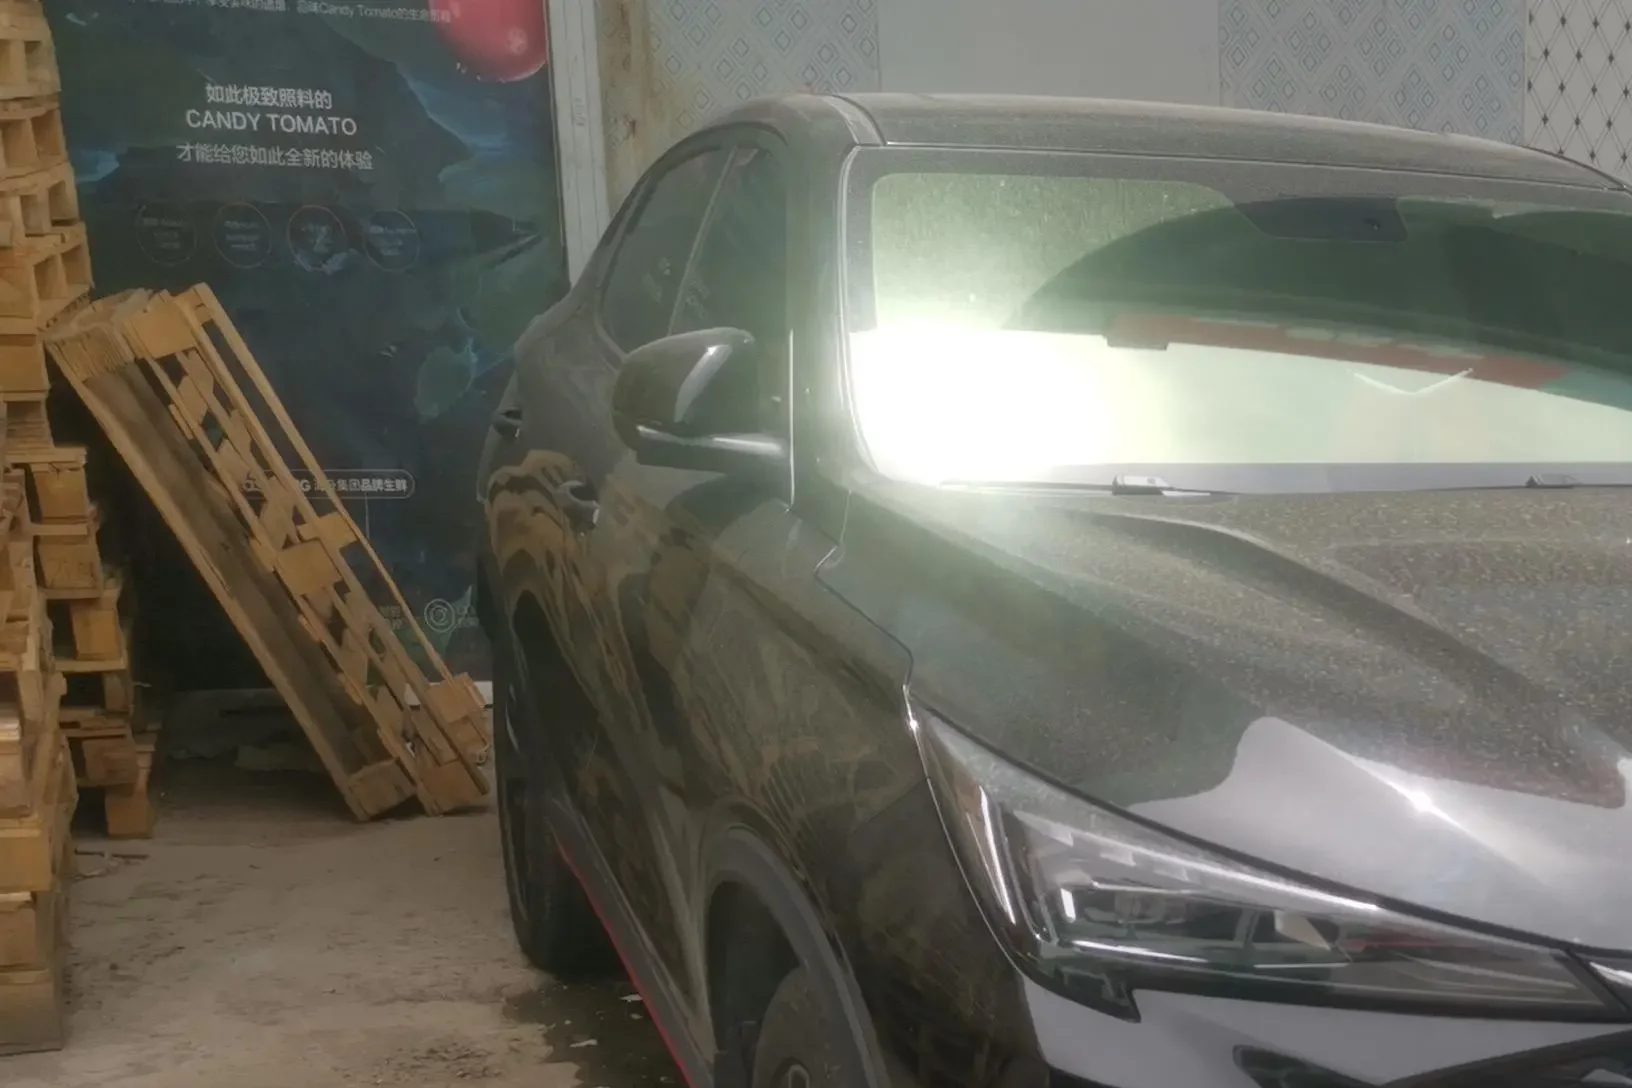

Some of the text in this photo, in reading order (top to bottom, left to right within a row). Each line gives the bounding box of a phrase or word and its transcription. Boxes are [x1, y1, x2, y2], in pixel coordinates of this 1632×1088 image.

[205, 84, 333, 110] 如此极致照料的
[185, 109, 358, 136] CANDY TOMATO
[176, 142, 374, 170] 才能给您如此全新的体验
